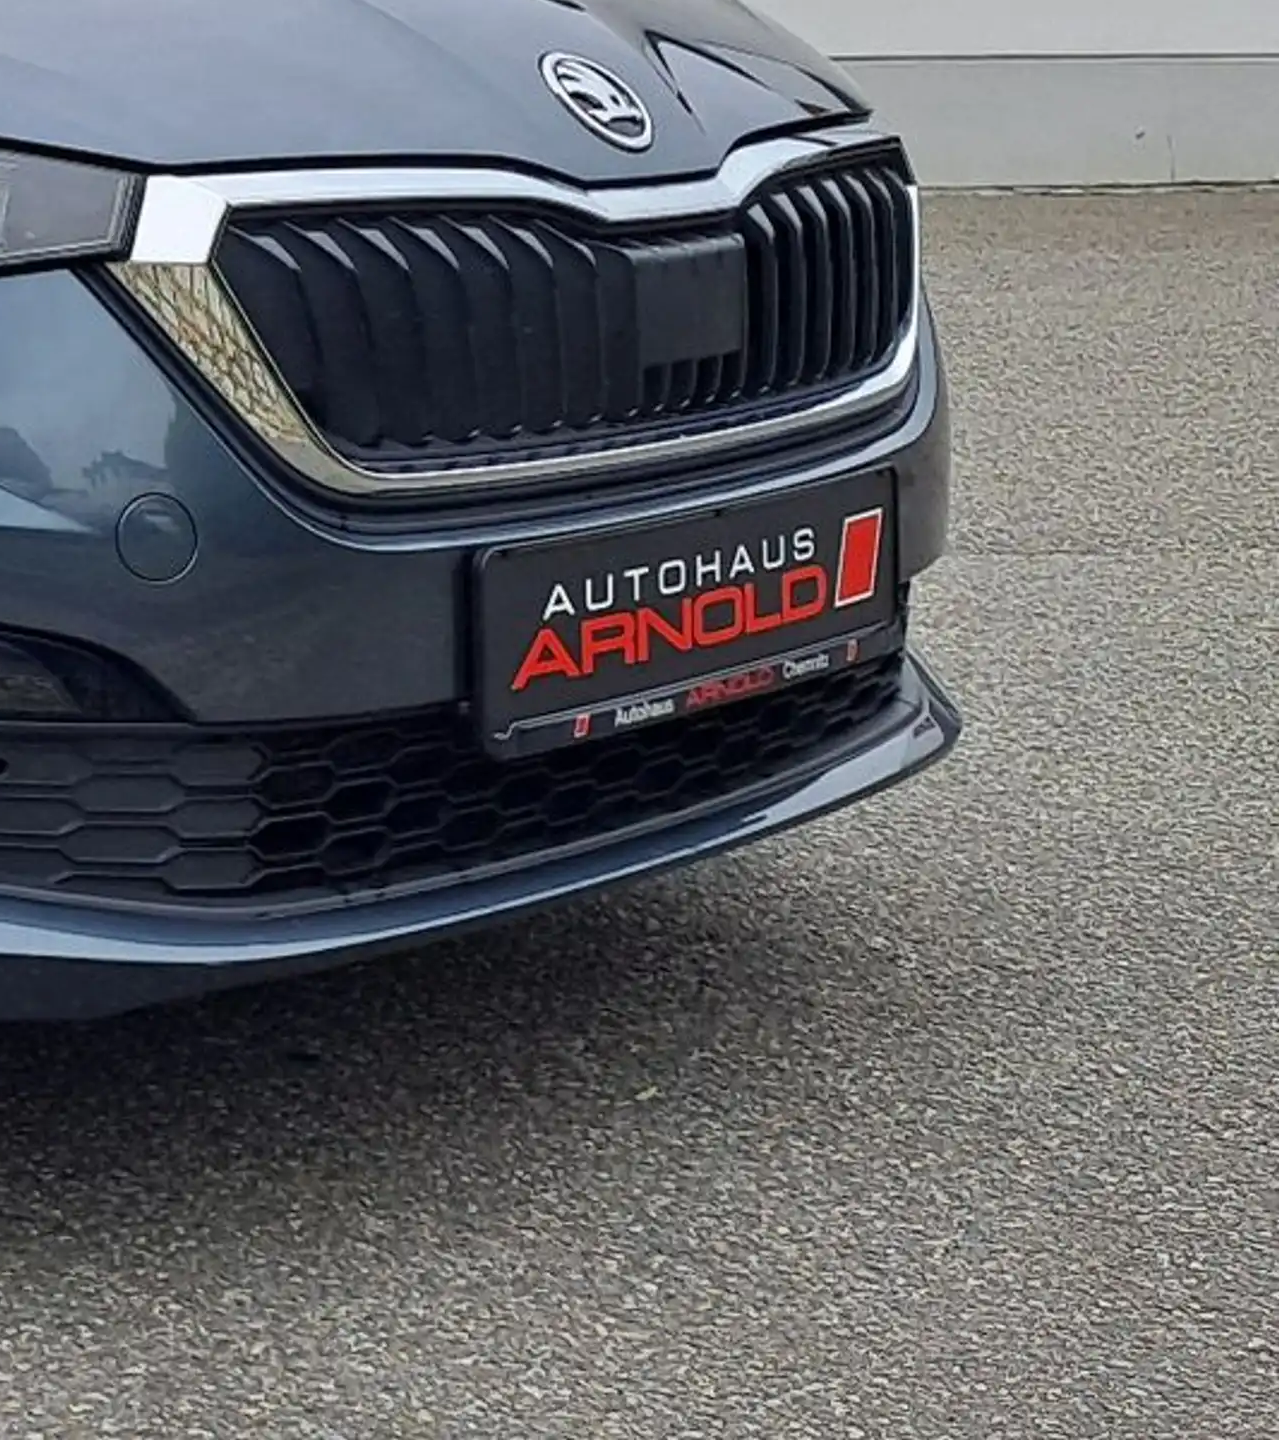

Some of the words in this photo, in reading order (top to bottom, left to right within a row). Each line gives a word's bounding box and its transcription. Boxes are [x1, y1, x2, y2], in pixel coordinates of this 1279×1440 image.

[541, 527, 817, 621] AUTOHAUS
[510, 563, 829, 691] ARNOLD
[614, 697, 676, 728] Autohaus
[685, 665, 776, 709] ARNOLD
